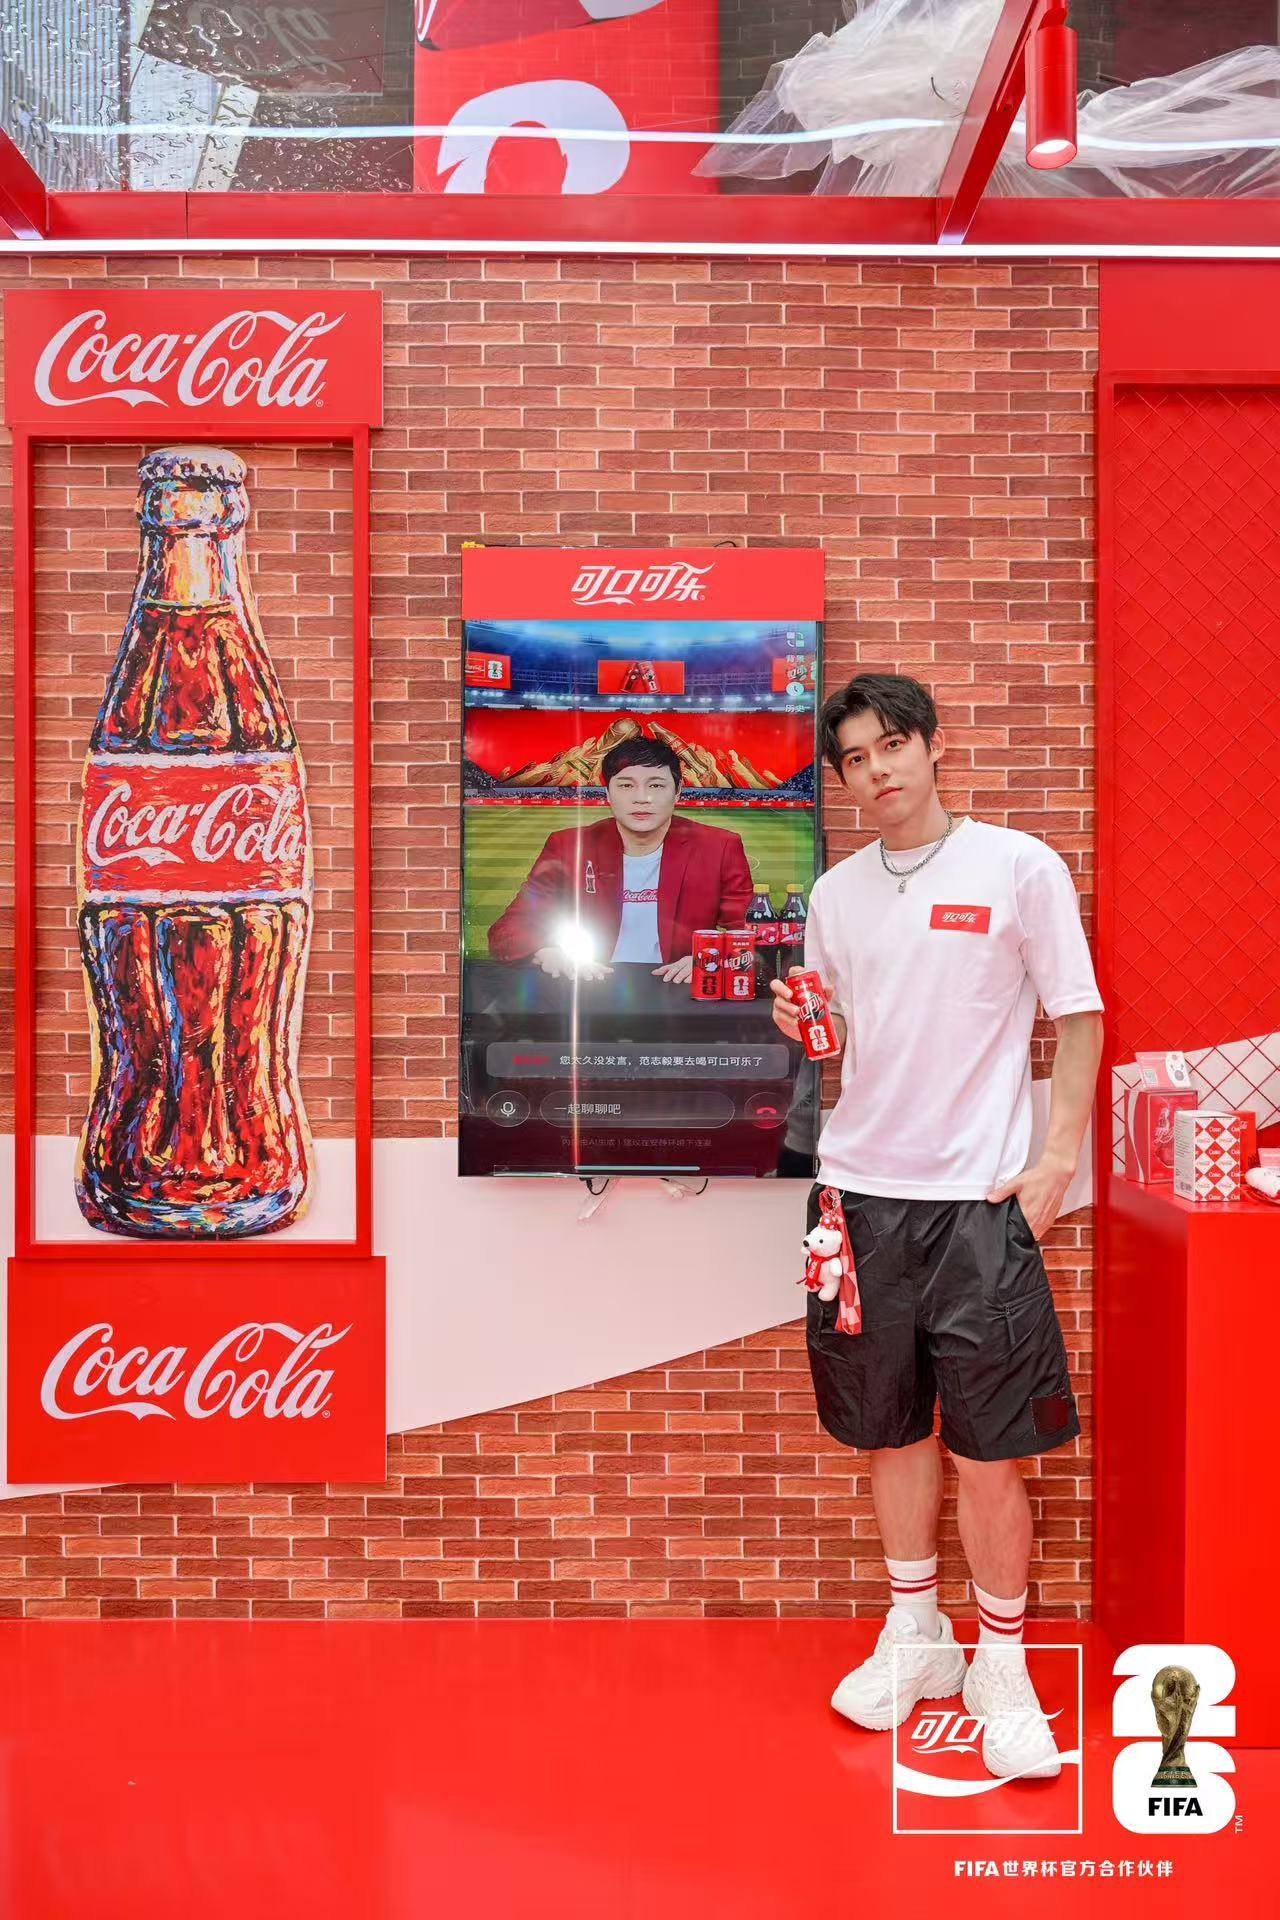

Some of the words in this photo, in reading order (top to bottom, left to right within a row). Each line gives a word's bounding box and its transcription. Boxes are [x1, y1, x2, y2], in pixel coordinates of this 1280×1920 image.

[34, 309, 346, 407] Coca-Cola
[570, 561, 715, 606] 可口可乐
[87, 783, 306, 867] Coca-Cola
[942, 911, 977, 923] 可口可乐
[554, 1102, 622, 1116] 一起聊聊吧
[40, 1322, 188, 1420] Coca
[184, 1322, 353, 1419] Cola
